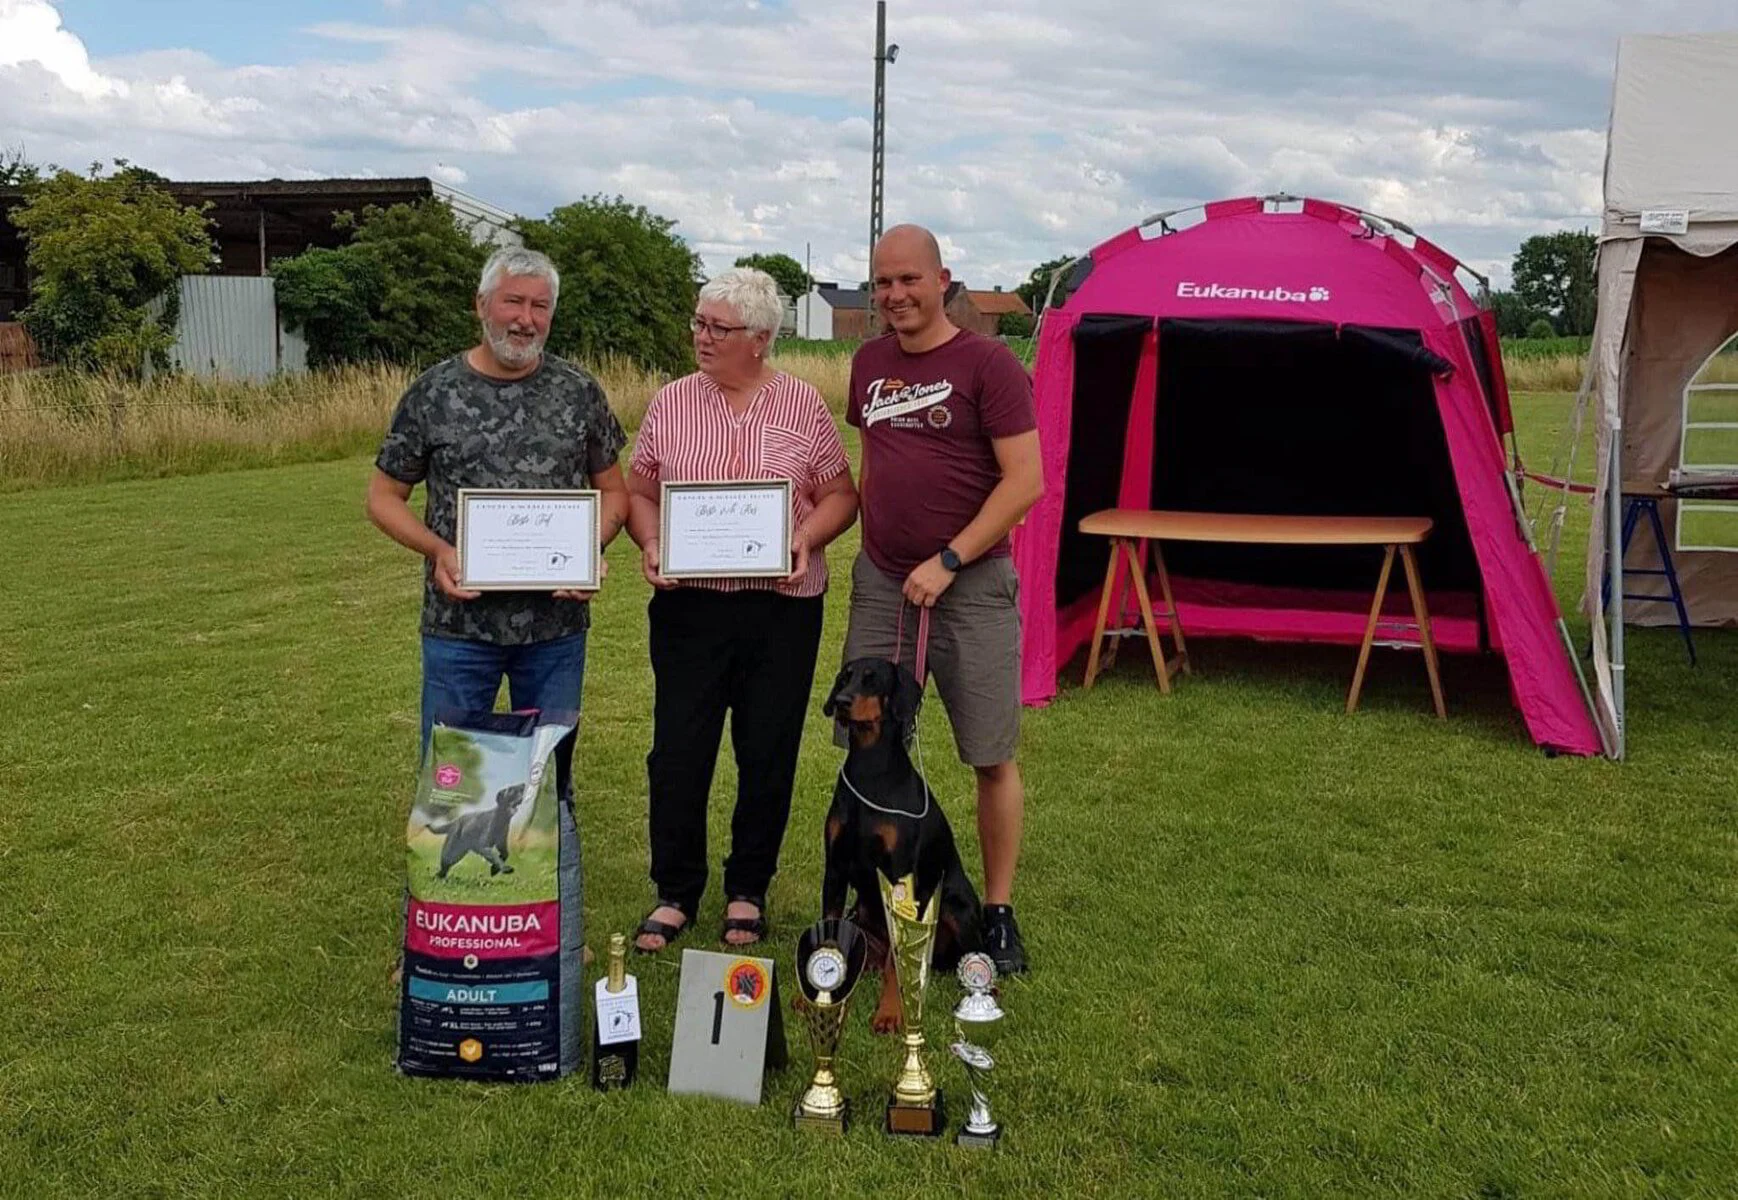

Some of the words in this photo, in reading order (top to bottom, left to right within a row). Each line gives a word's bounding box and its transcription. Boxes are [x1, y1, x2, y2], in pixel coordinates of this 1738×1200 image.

[1177, 282, 1306, 302] Eukanuba
[862, 378, 899, 418] Jack
[912, 379, 950, 398] Jones
[416, 909, 541, 933] EUKANUBA
[429, 935, 521, 949] PROFESSIONAL
[446, 989, 497, 1001] ADULT
[711, 991, 725, 1045] 1
